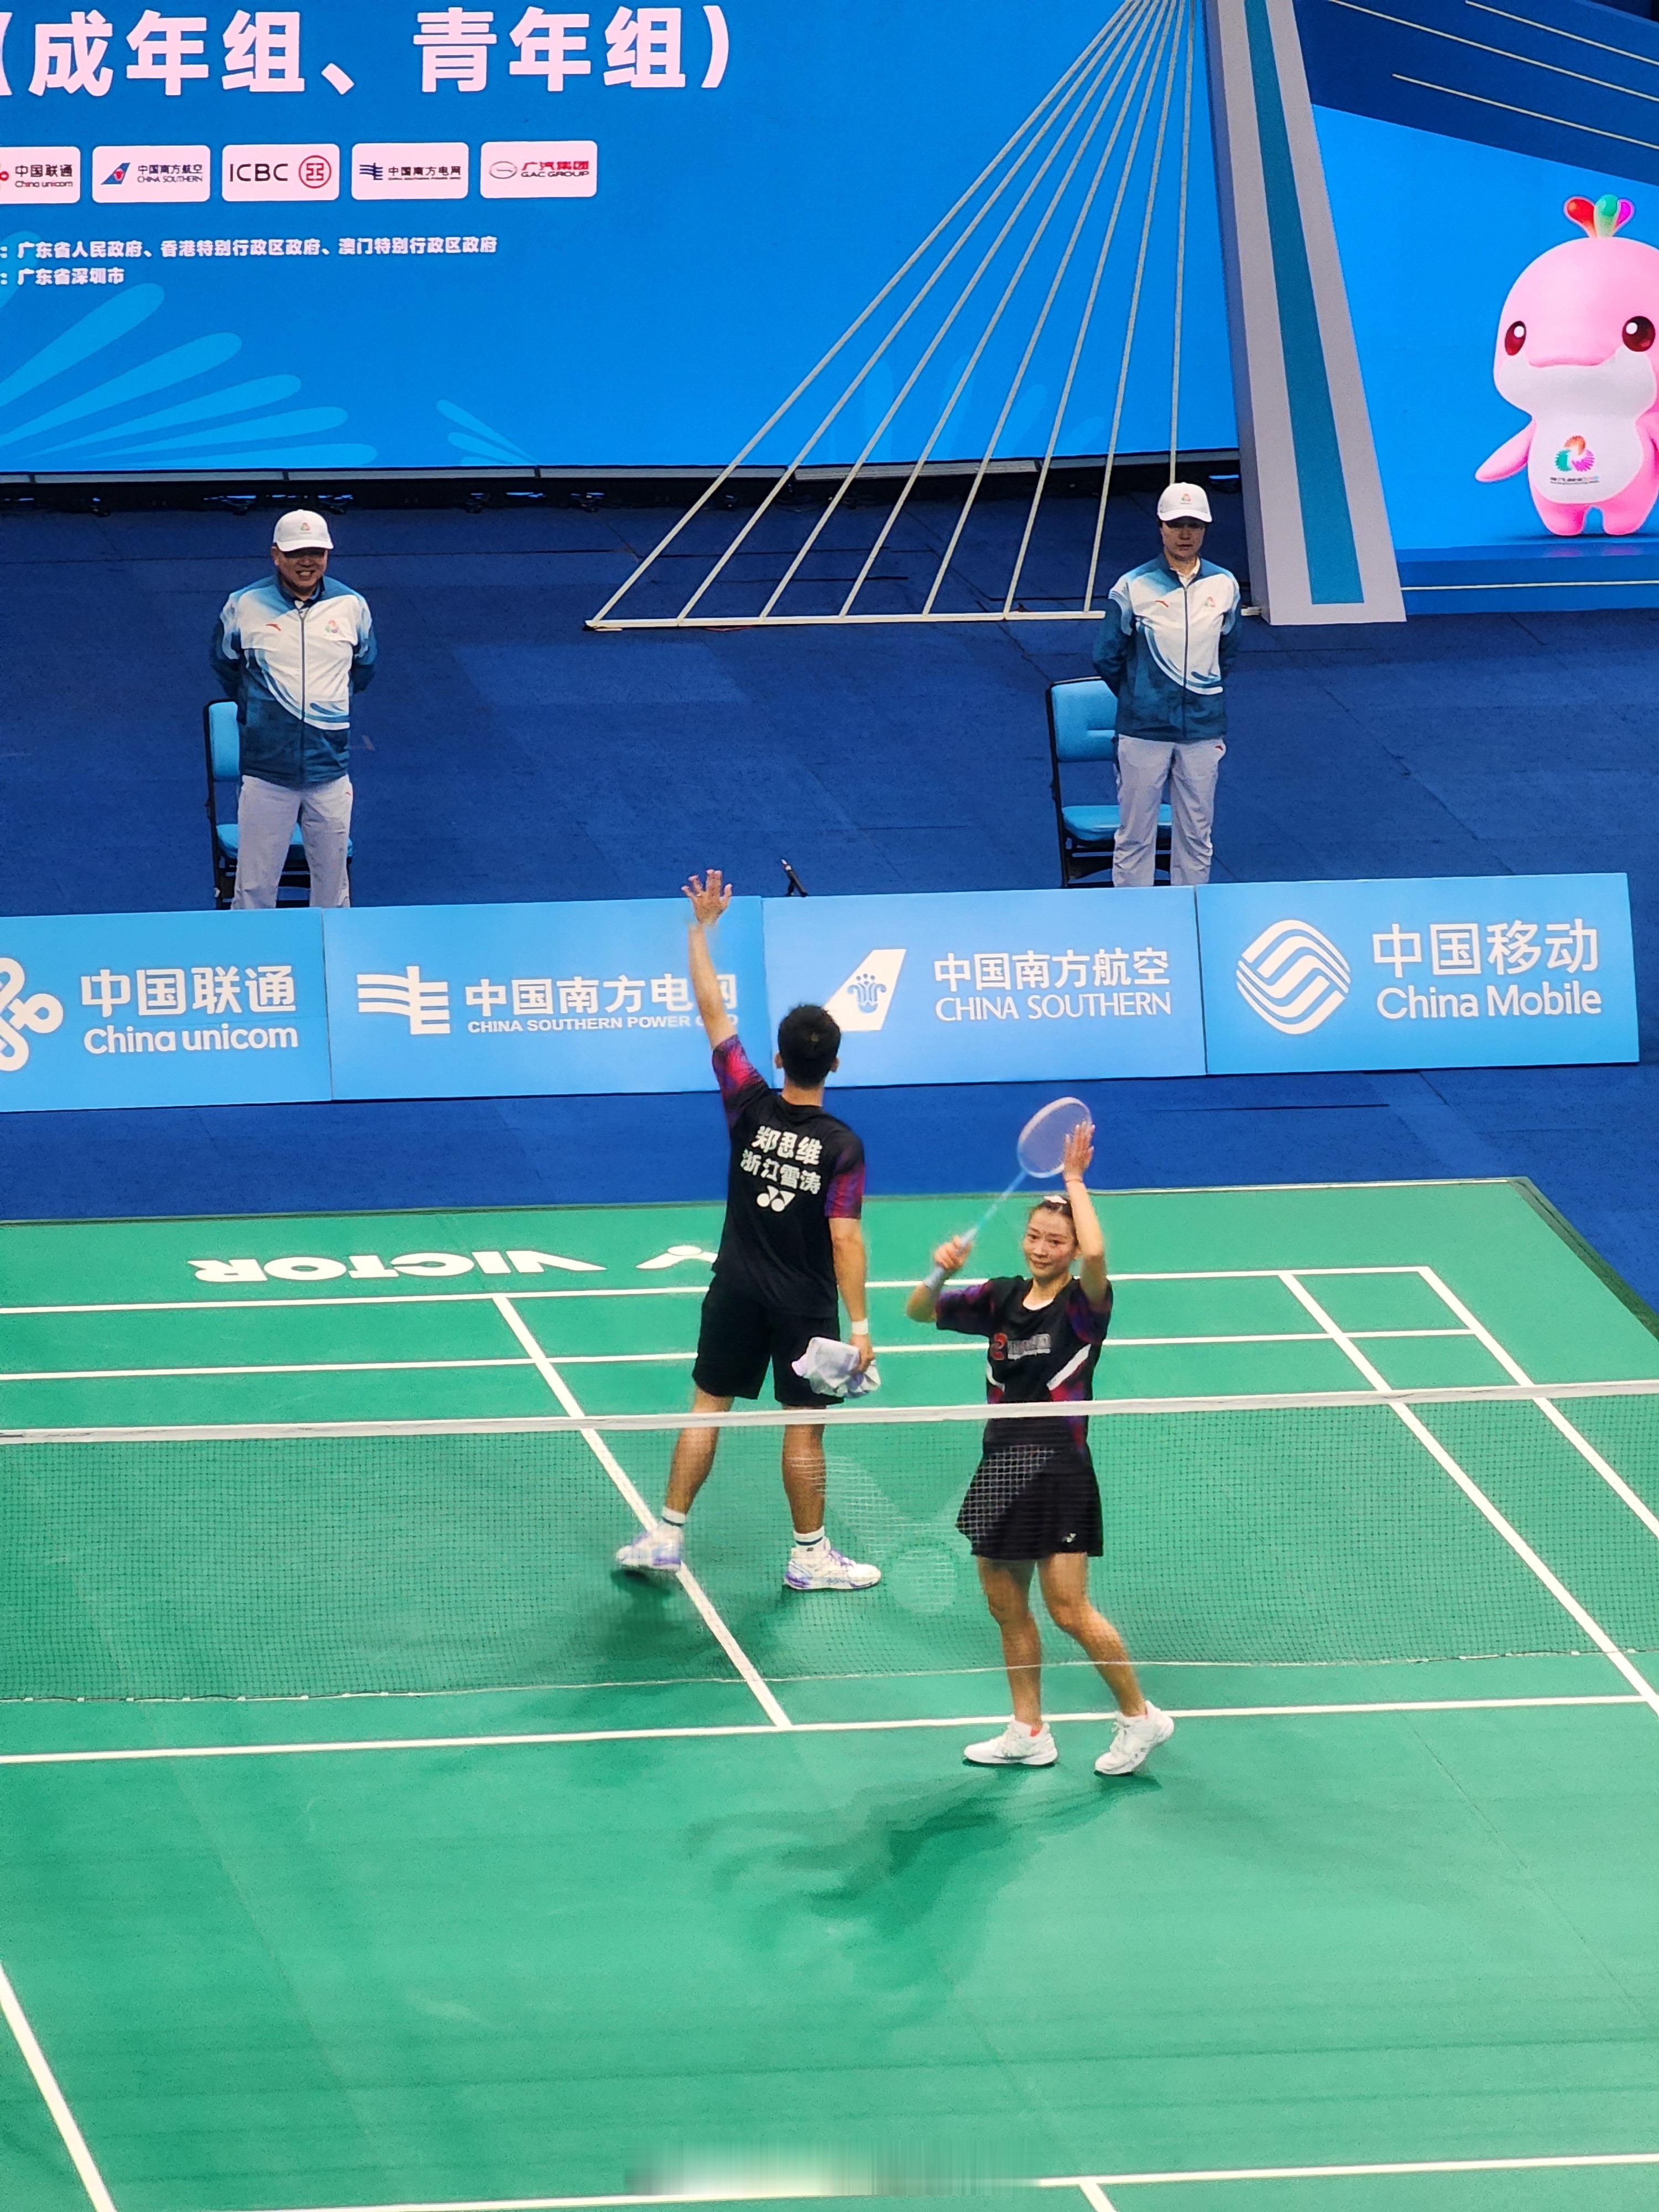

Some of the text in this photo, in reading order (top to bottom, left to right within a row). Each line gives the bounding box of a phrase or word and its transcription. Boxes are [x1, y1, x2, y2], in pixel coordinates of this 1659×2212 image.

[15, 164, 72, 178] 中国联通
[229, 163, 289, 182] ICBC
[521, 160, 589, 171] 广汽集团
[1372, 919, 1598, 978] 中国移动
[933, 947, 1170, 992] 中国南方航空
[81, 965, 296, 1018] 中国联通
[935, 992, 1171, 1021] CHINA SOUTHERN
[1376, 980, 1602, 1019] China Mobile
[84, 1023, 299, 1054] China unicom
[468, 1020, 524, 1033] CHINA
[526, 1016, 623, 1031] SOUTHERN
[627, 1015, 691, 1028] POWER
[751, 1126, 823, 1165] 郑思维
[739, 1149, 822, 1194] 浙江雪涛
[187, 1250, 607, 1282] VICTOR
